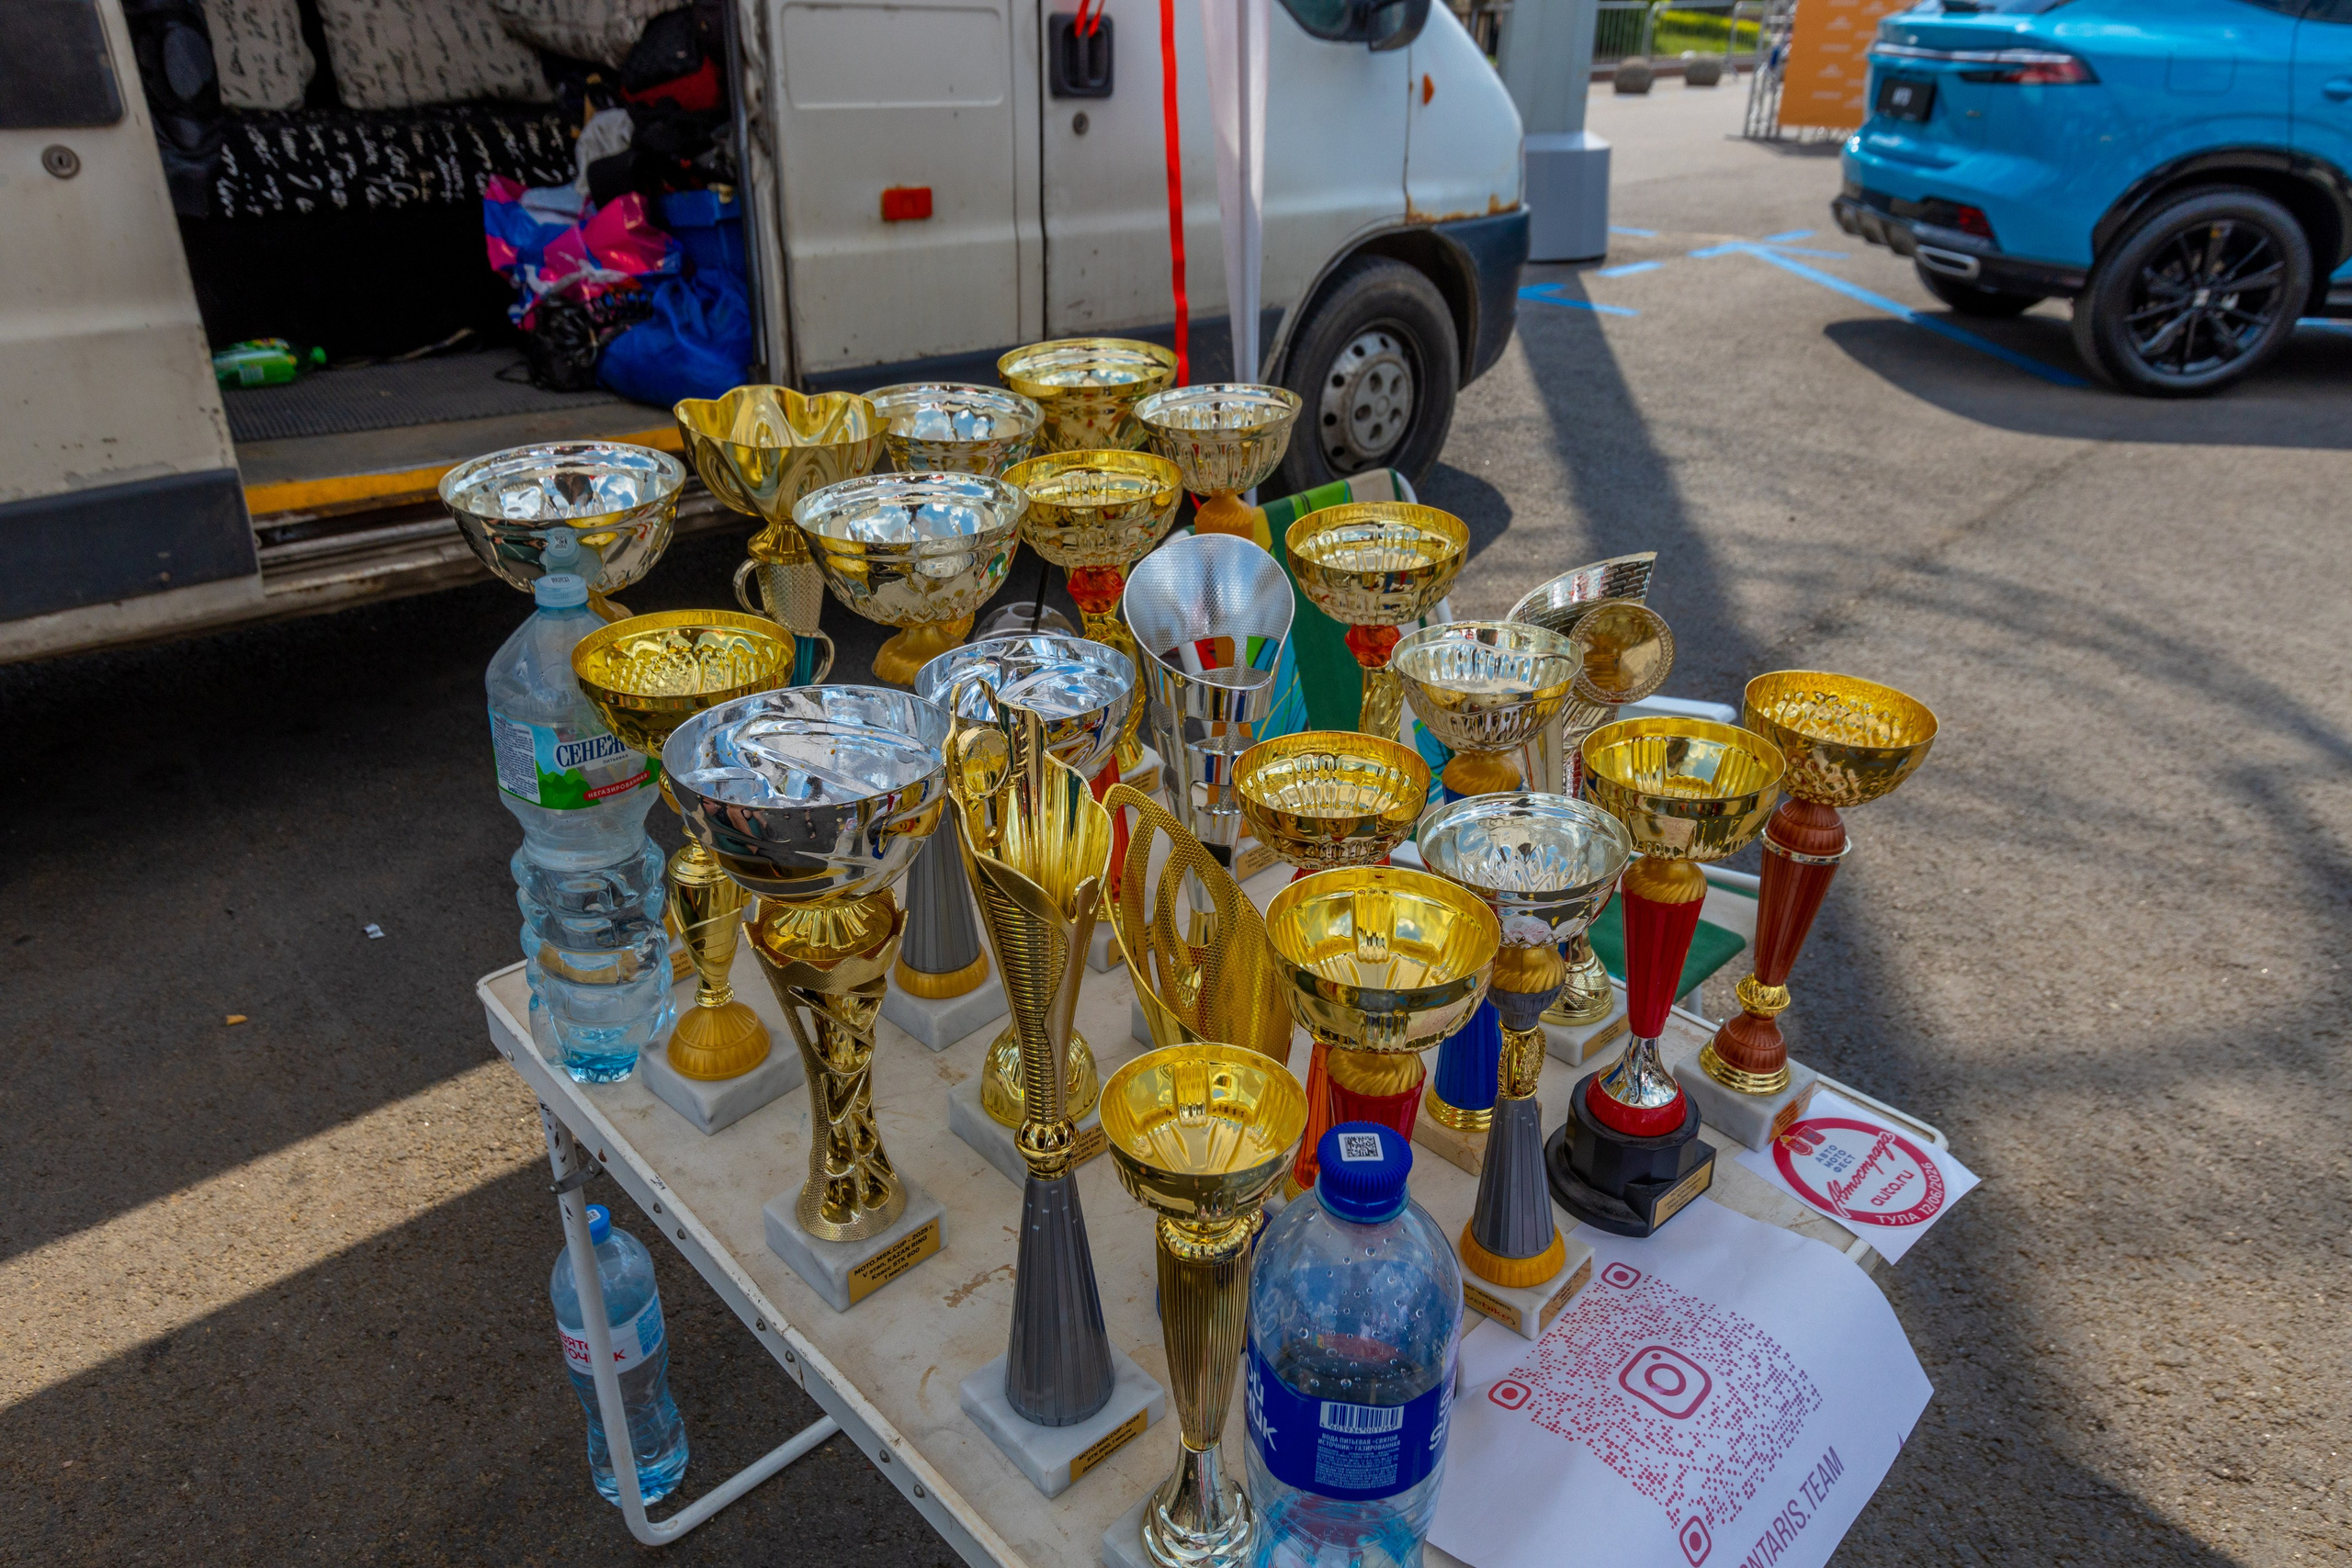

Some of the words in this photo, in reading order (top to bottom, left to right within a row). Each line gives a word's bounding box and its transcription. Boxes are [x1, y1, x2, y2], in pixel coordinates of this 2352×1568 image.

[556, 734, 630, 769] СЕНЕЖ
[603, 753, 629, 764] ПИТЬЕВАЯ
[588, 773, 648, 799] НЕГАЗИРОВАННАЯ
[1815, 1144, 1838, 1164] АВТО
[1824, 1149, 1847, 1169] МОТО
[1834, 1155, 1856, 1173] ФЕСТ
[1826, 1131, 1895, 1219] Автострада
[1870, 1169, 1915, 1206] auto.ru
[1875, 1211, 1921, 1225] ТУЛА
[1917, 1162, 1944, 1216] 12/06/2026
[854, 1241, 907, 1275] MOTO.MSK.CUP
[912, 1227, 928, 1239] 2025
[869, 1262, 886, 1274] этап,
[888, 1247, 910, 1263] KAZAN
[911, 1235, 927, 1247] RING
[872, 1266, 891, 1280] Класс
[893, 1257, 905, 1267] STK
[907, 1247, 920, 1258] 600
[889, 1263, 909, 1277] место
[1321, 1432, 1339, 1443] ВОДА
[1339, 1437, 1371, 1445] ПИТЬЕВАЯ
[1354, 1439, 1401, 1451] ГАЗИРОВАННАЯ
